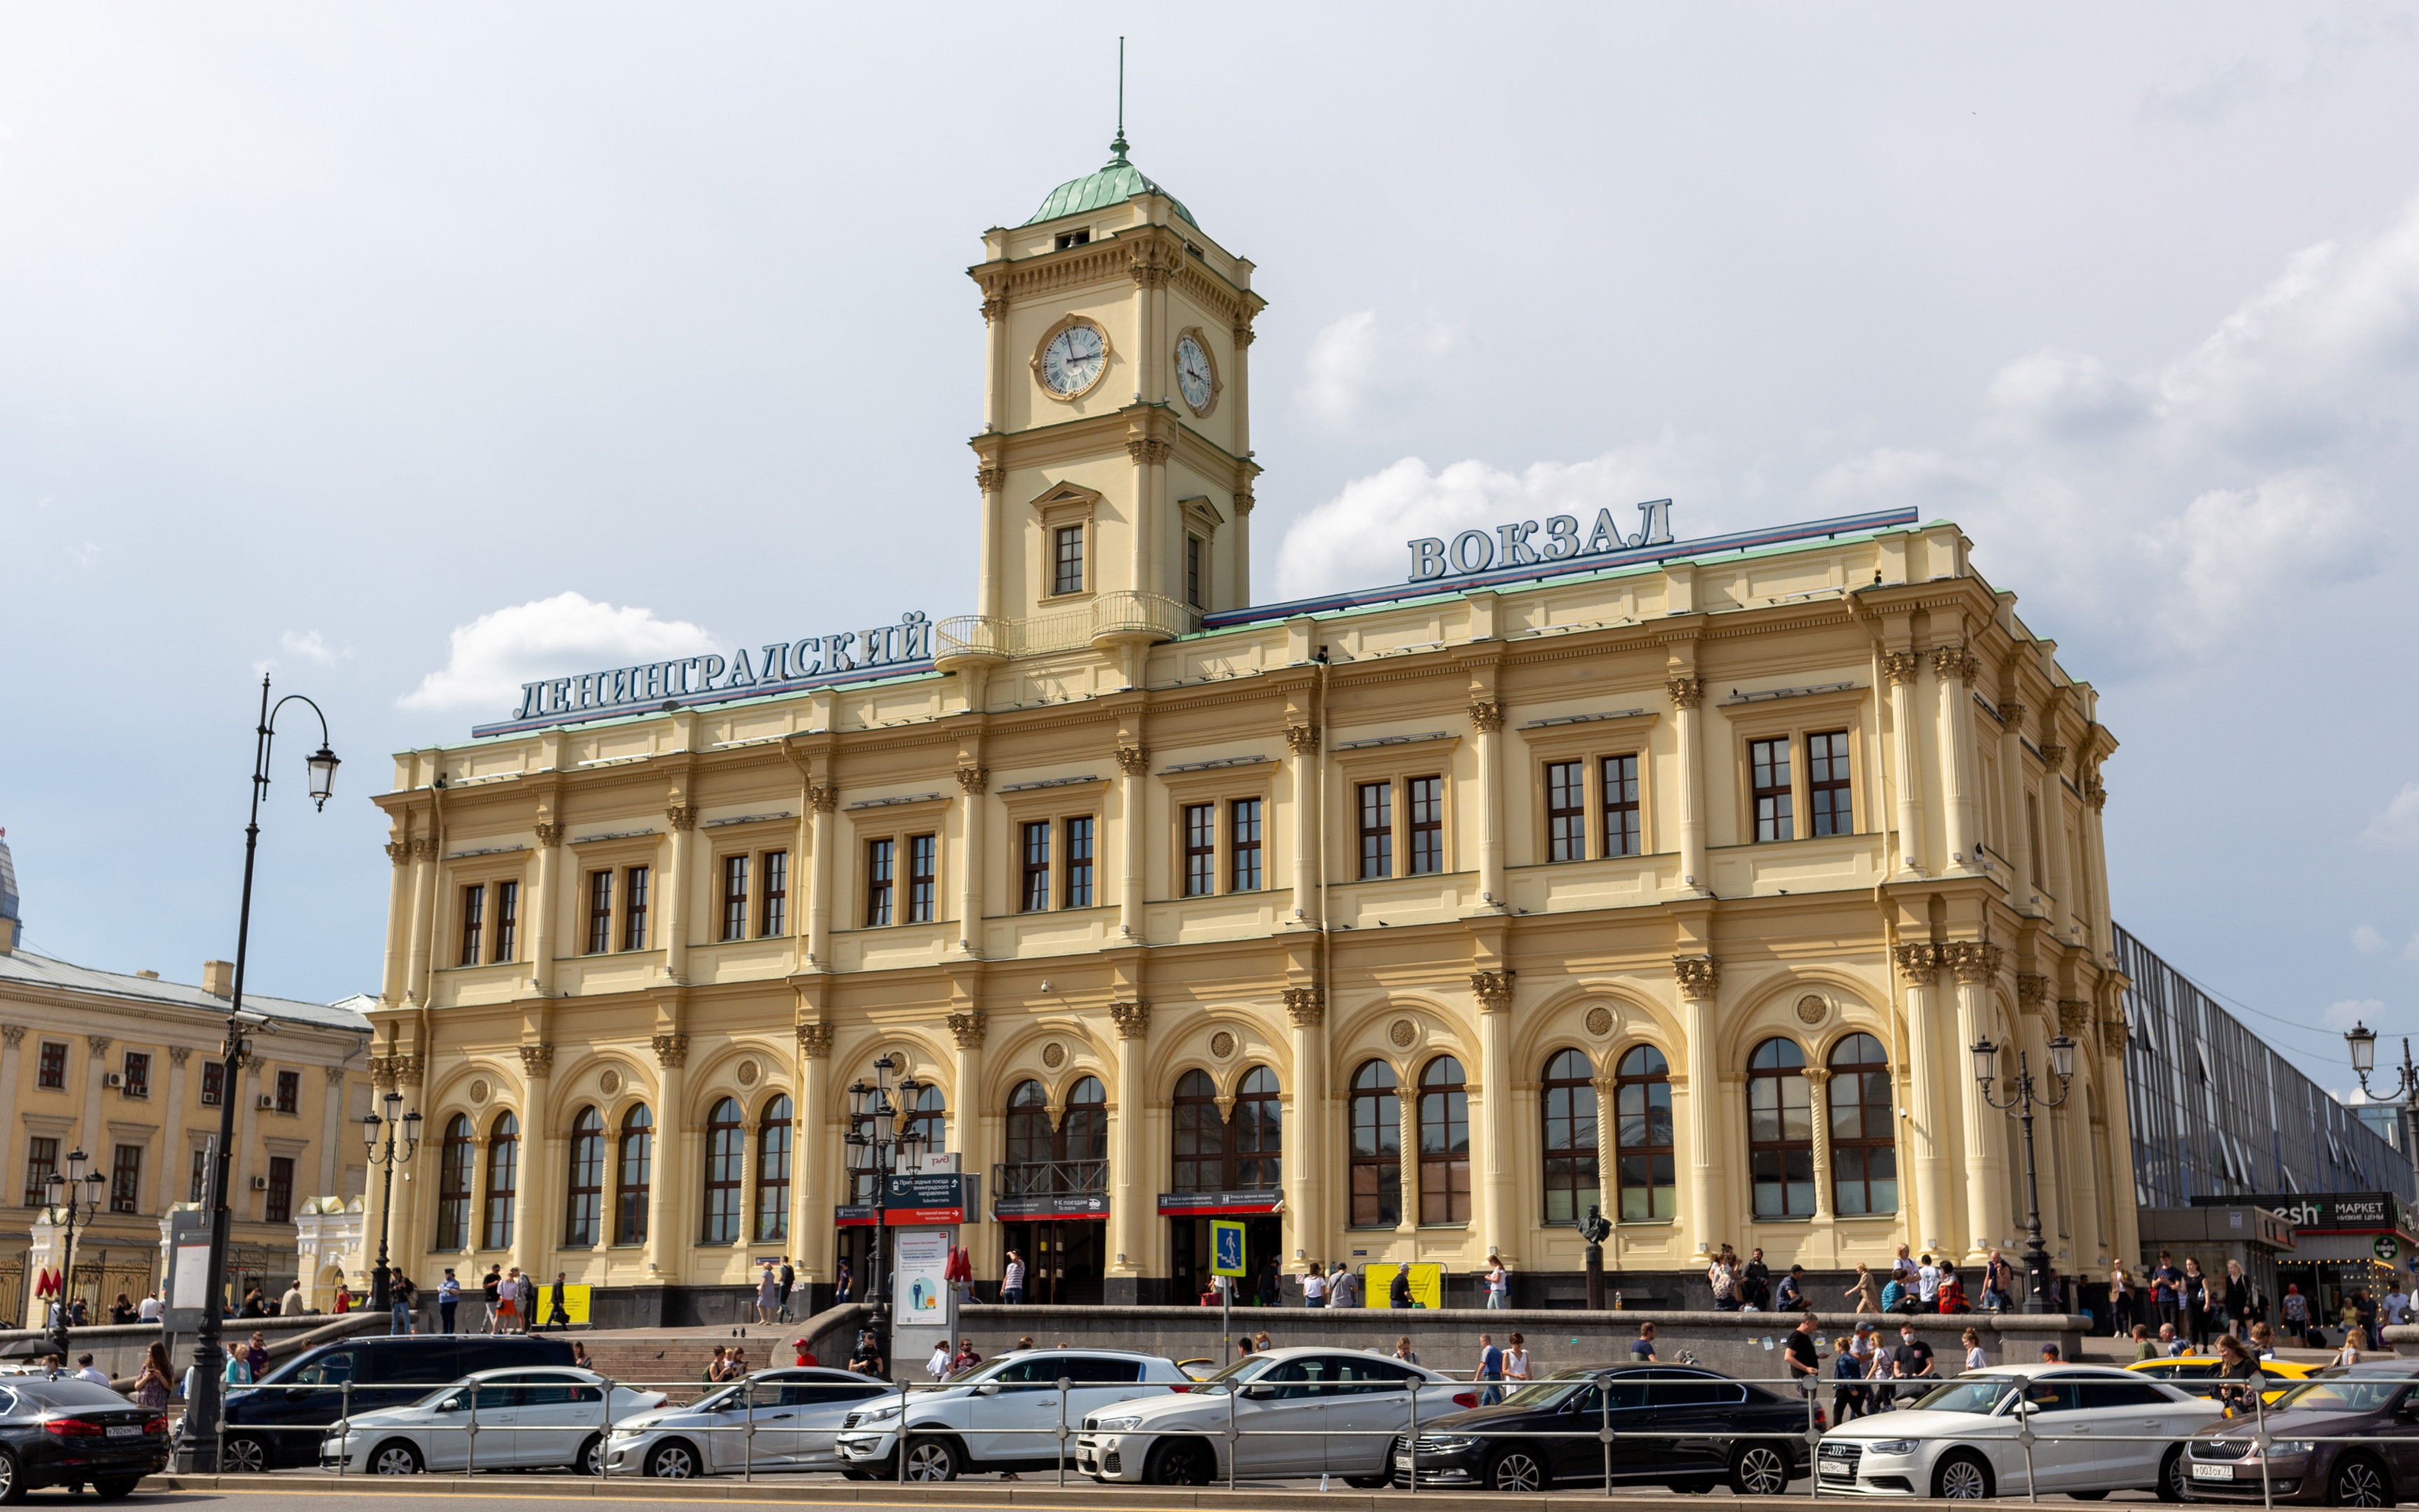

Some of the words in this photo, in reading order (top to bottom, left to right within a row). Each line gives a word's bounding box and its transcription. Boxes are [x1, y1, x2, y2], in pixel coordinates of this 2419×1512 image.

[1408, 498, 1674, 583] ВОКЗАЛ
[513, 611, 932, 719] ЛЕНИНГРАДСКИЙ
[2336, 1202, 2383, 1214] МАРКЕТ
